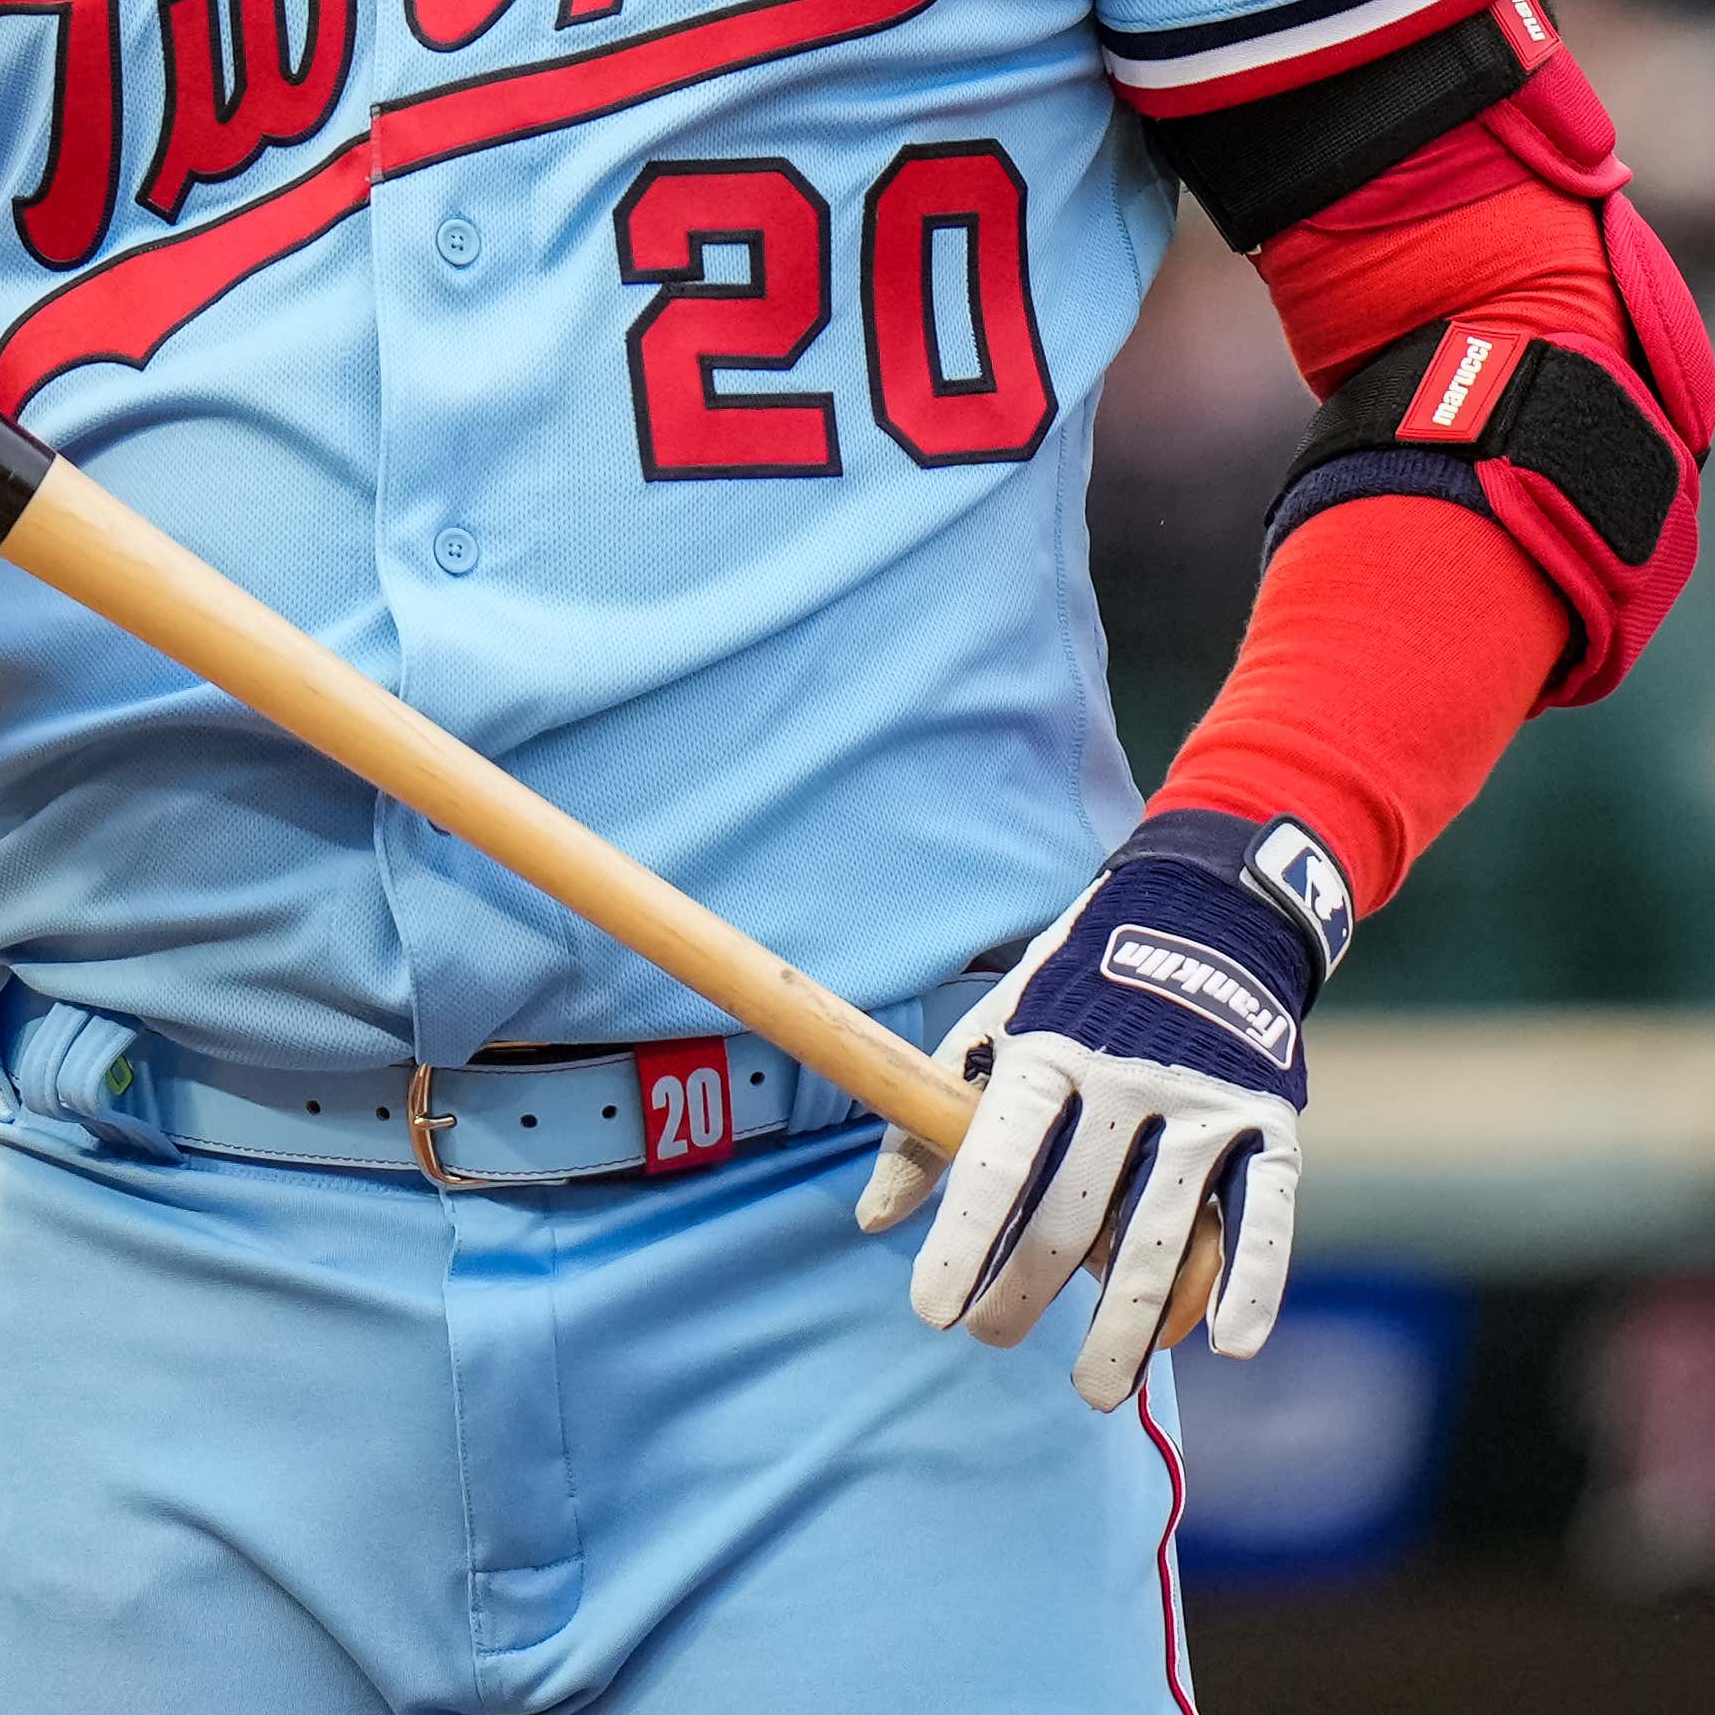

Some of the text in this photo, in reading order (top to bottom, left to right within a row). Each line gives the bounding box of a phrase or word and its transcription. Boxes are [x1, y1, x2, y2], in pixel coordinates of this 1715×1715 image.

[614, 138, 1058, 483] 20
[1432, 336, 1492, 427] marucci
[1112, 941, 1288, 1049] Franklin
[651, 1067, 724, 1161] 20
